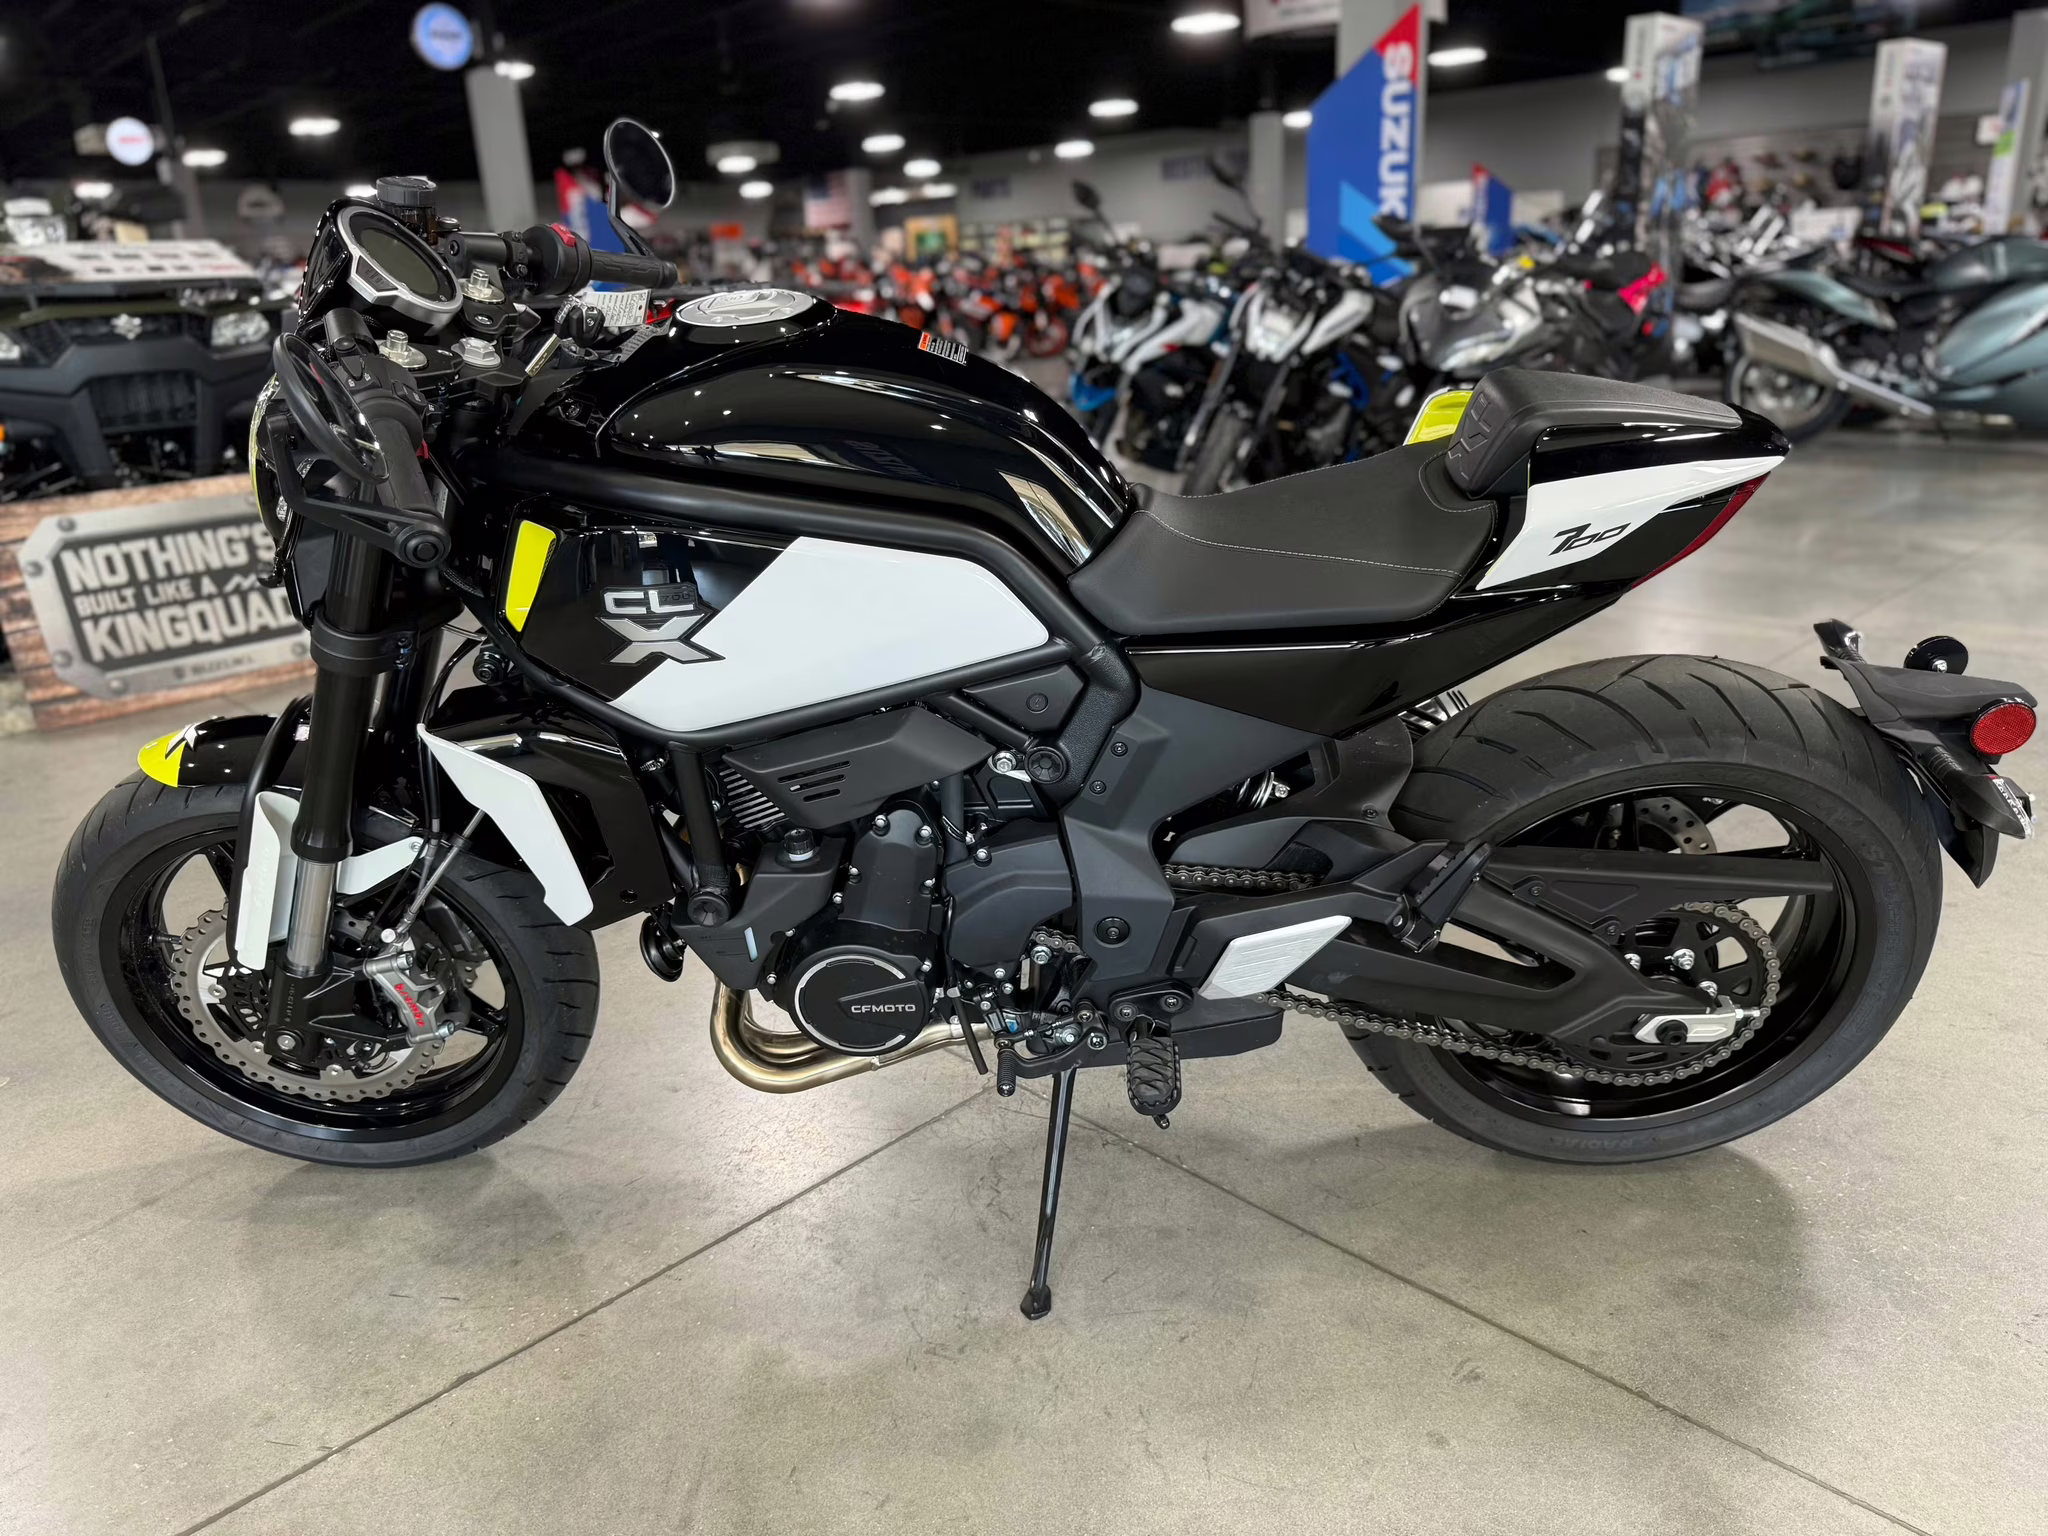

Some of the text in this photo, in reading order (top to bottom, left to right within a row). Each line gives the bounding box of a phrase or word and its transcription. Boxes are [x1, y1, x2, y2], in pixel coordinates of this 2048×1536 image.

[1379, 40, 1414, 222] SUZUK
[59, 523, 276, 593] NOTHING'S
[1548, 522, 1632, 556] 700
[73, 576, 218, 618] BUILT LIKE A
[851, 1004, 916, 1013] CFMOTO
